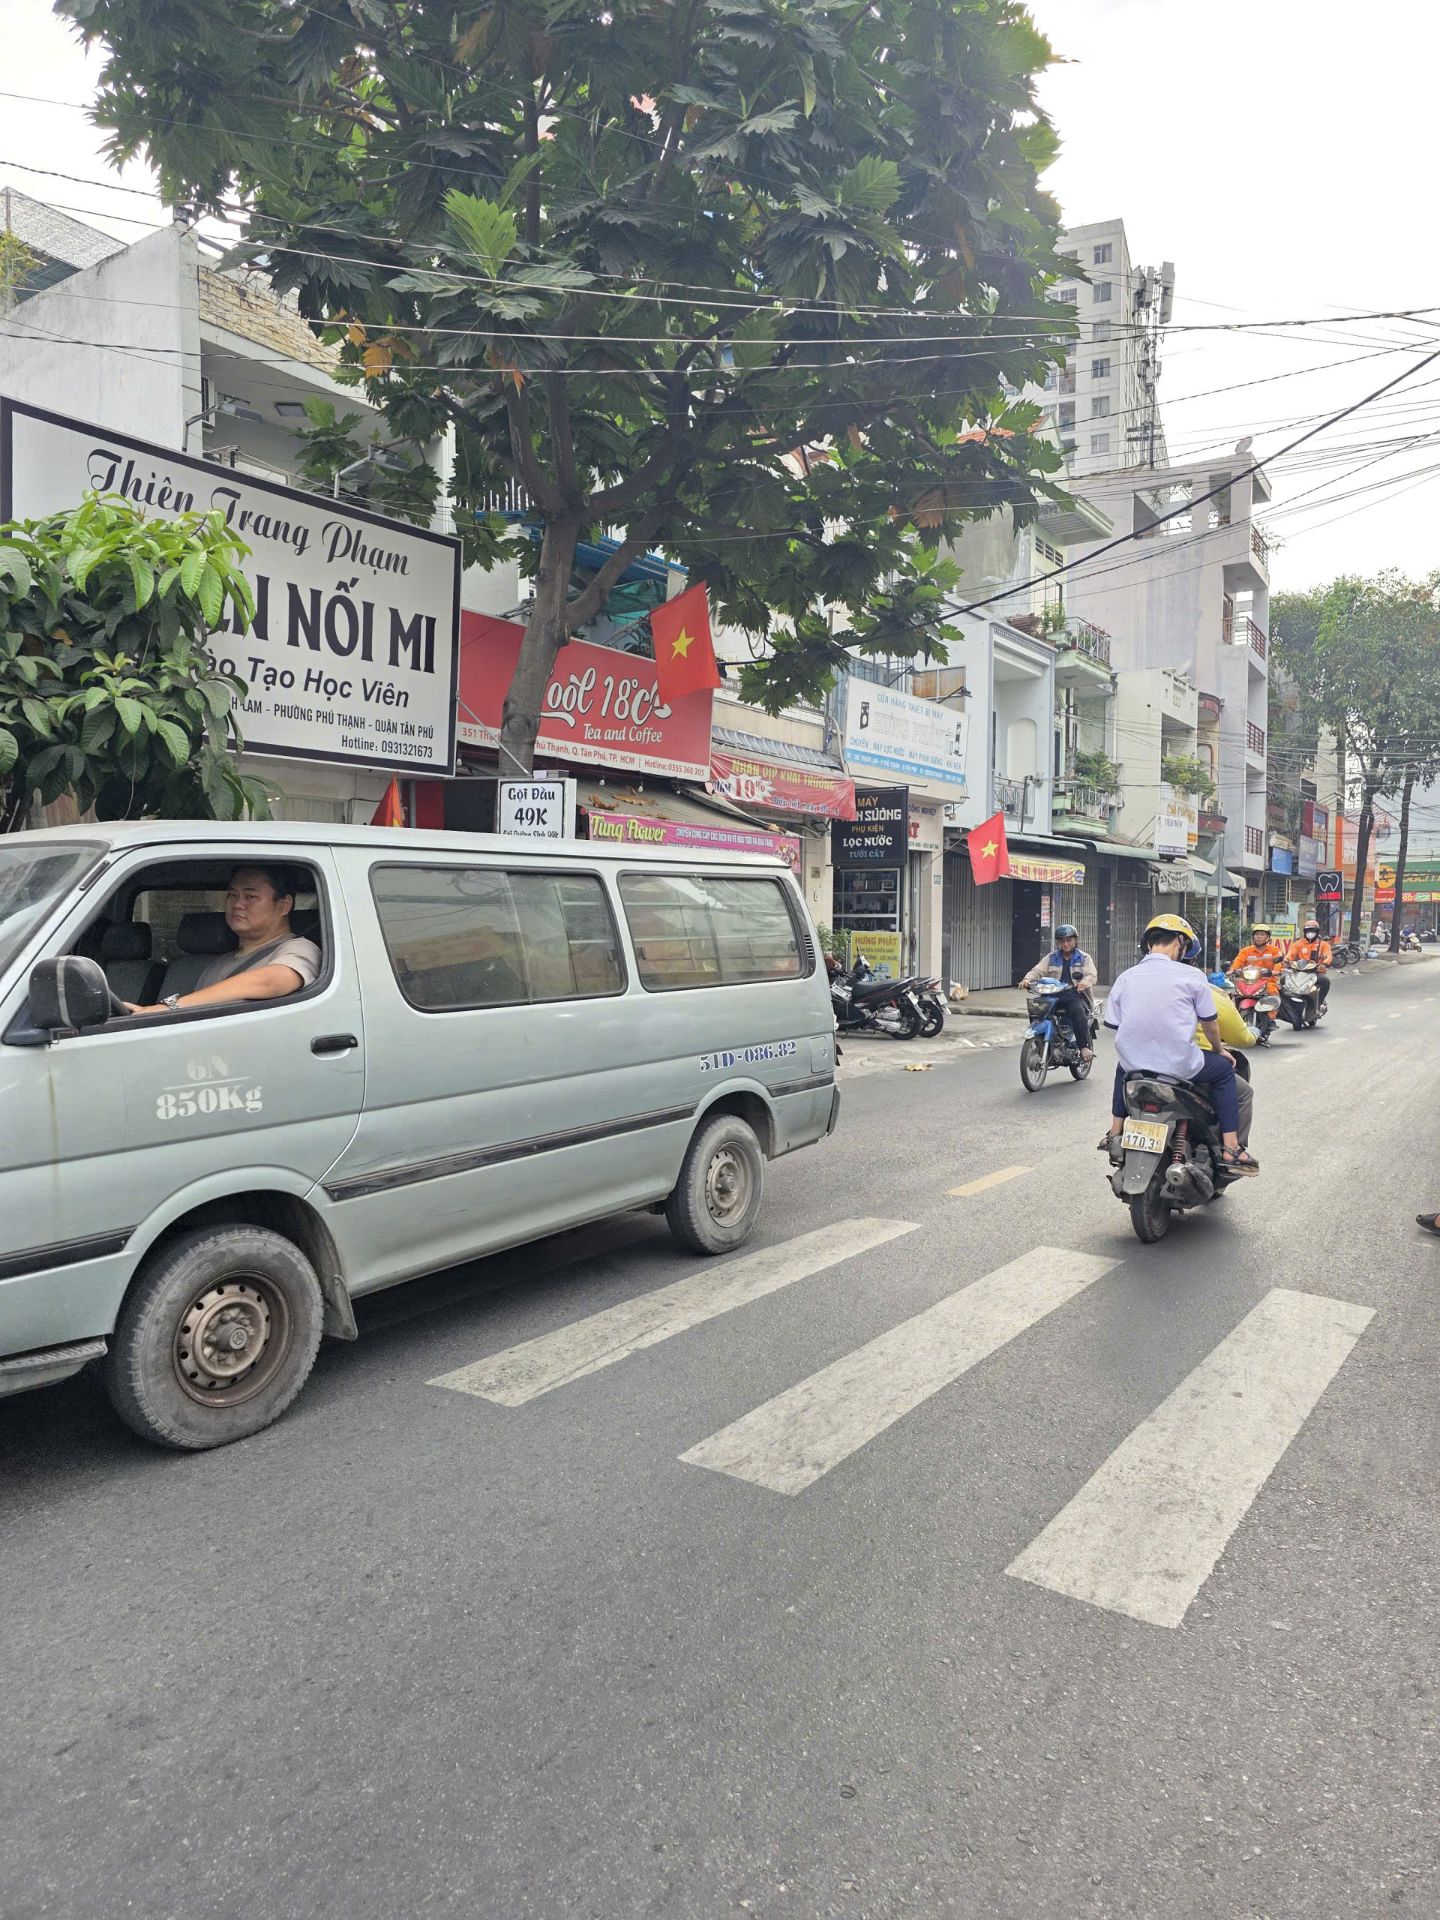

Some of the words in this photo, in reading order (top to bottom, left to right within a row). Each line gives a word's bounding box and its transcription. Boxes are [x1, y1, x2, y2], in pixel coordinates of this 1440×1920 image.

[87, 449, 194, 512] Thiên
[211, 487, 312, 556] Trang
[322, 521, 410, 576] Phạm
[286, 577, 375, 662] NỐI
[388, 607, 437, 673] MI
[247, 656, 296, 692] Tạo
[303, 668, 353, 702] Học
[361, 678, 410, 708] Viên
[273, 703, 313, 722] PHƯỜNG
[316, 707, 334, 726] PHÚ
[336, 712, 366, 730] THẠNH
[375, 717, 398, 736] QUẬN
[400, 722, 416, 738] TÂN
[417, 724, 434, 740] PHÚ
[583, 723, 602, 741] Tea
[604, 727, 626, 743] and
[628, 726, 663, 745] Coffee
[341, 735, 378, 752] Hotline:
[381, 740, 433, 759] 0931321673
[462, 727, 478, 738] 351
[535, 741, 546, 751] hú
[546, 742, 571, 757] Thạnh,
[572, 746, 580, 757] Q.
[580, 747, 594, 758] Tân
[609, 752, 619, 762] TP.
[620, 755, 635, 765] HCM
[514, 807, 548, 826] 49K
[857, 796, 879, 807] MÁY
[626, 816, 667, 843] Flower
[843, 837, 862, 848] LỌC
[864, 834, 893, 847] NƯỚC
[156, 1085, 263, 1120] 850Kg
